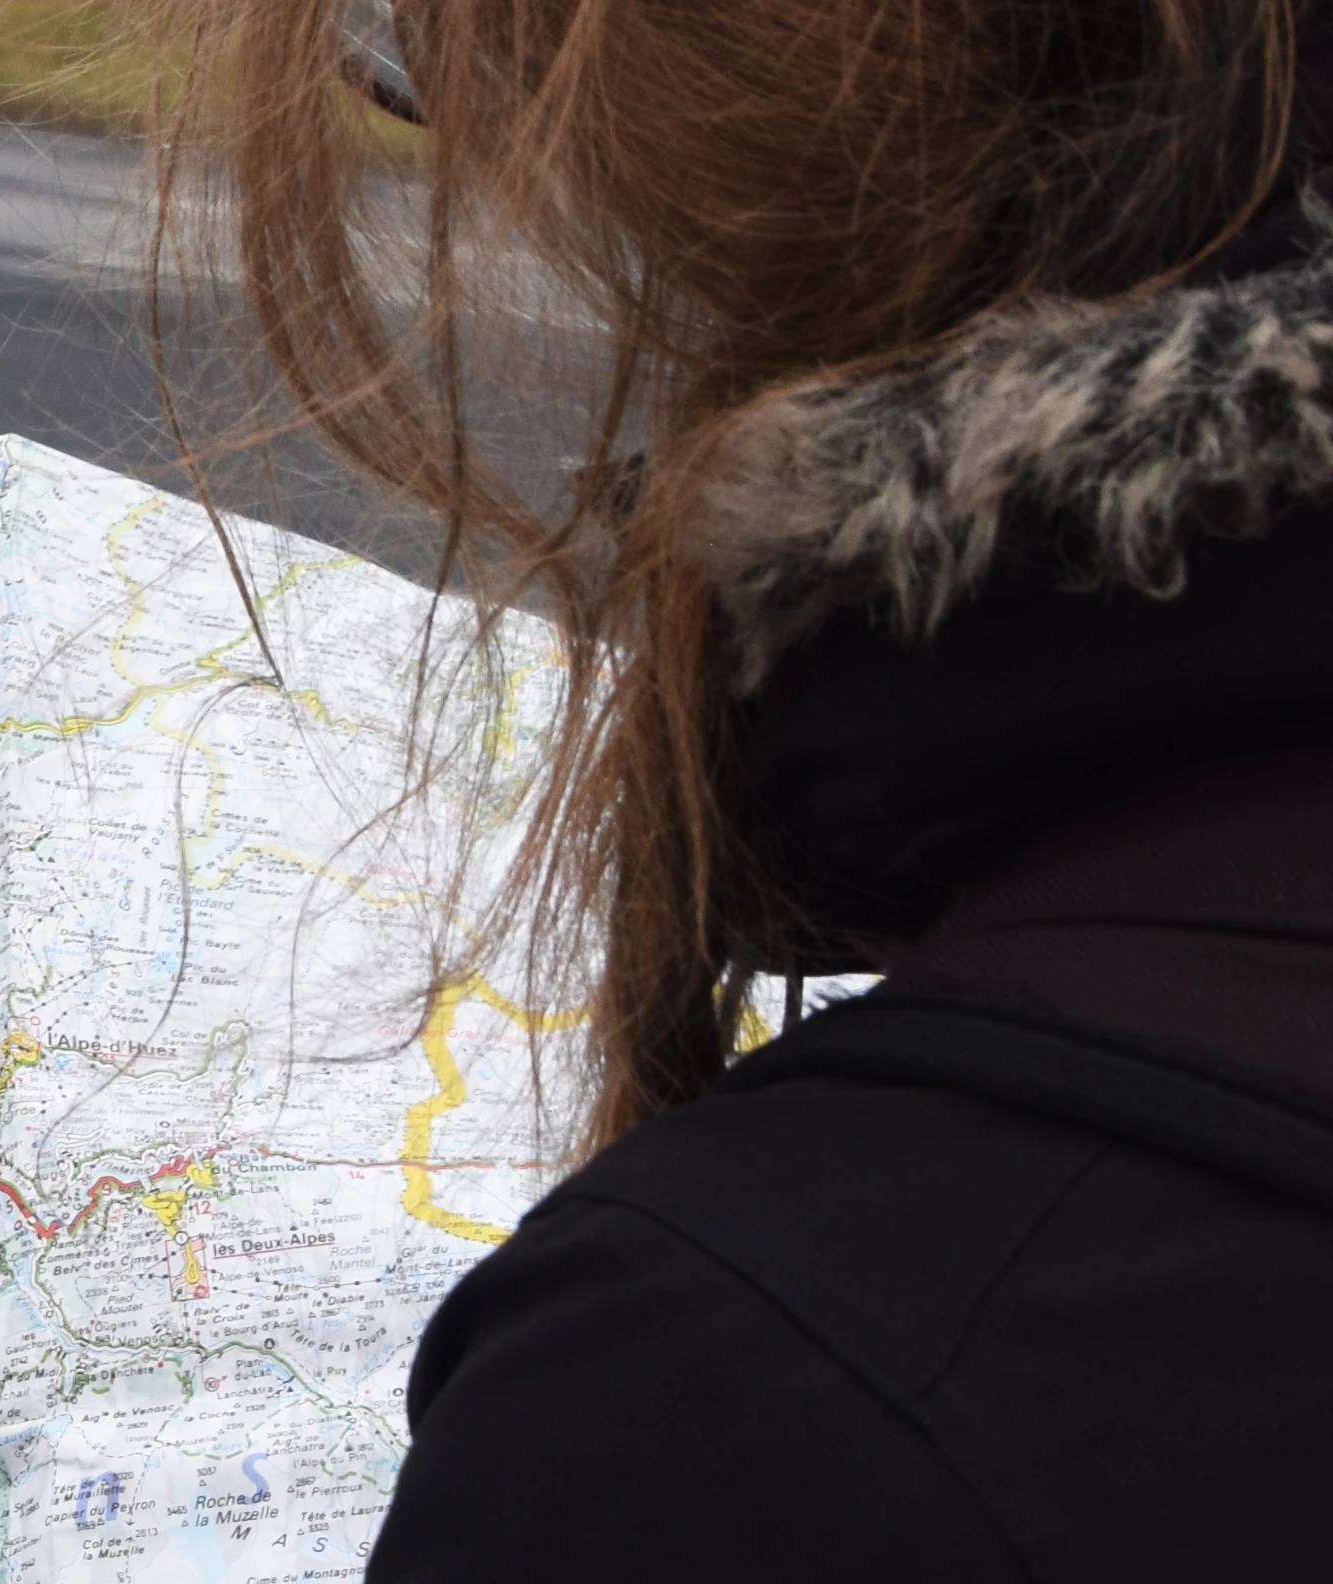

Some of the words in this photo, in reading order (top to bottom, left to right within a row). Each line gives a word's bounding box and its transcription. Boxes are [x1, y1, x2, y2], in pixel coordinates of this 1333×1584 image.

[48, 1030, 178, 1055] l'Alpe-d'Huez
[193, 1201, 212, 1215] 12
[213, 1241, 233, 1257] les
[237, 1230, 336, 1256] Deux-Alpes
[196, 1494, 247, 1510] Roche
[252, 1489, 271, 1503] de
[195, 1514, 211, 1527] la
[215, 1507, 278, 1524] Muzelle
